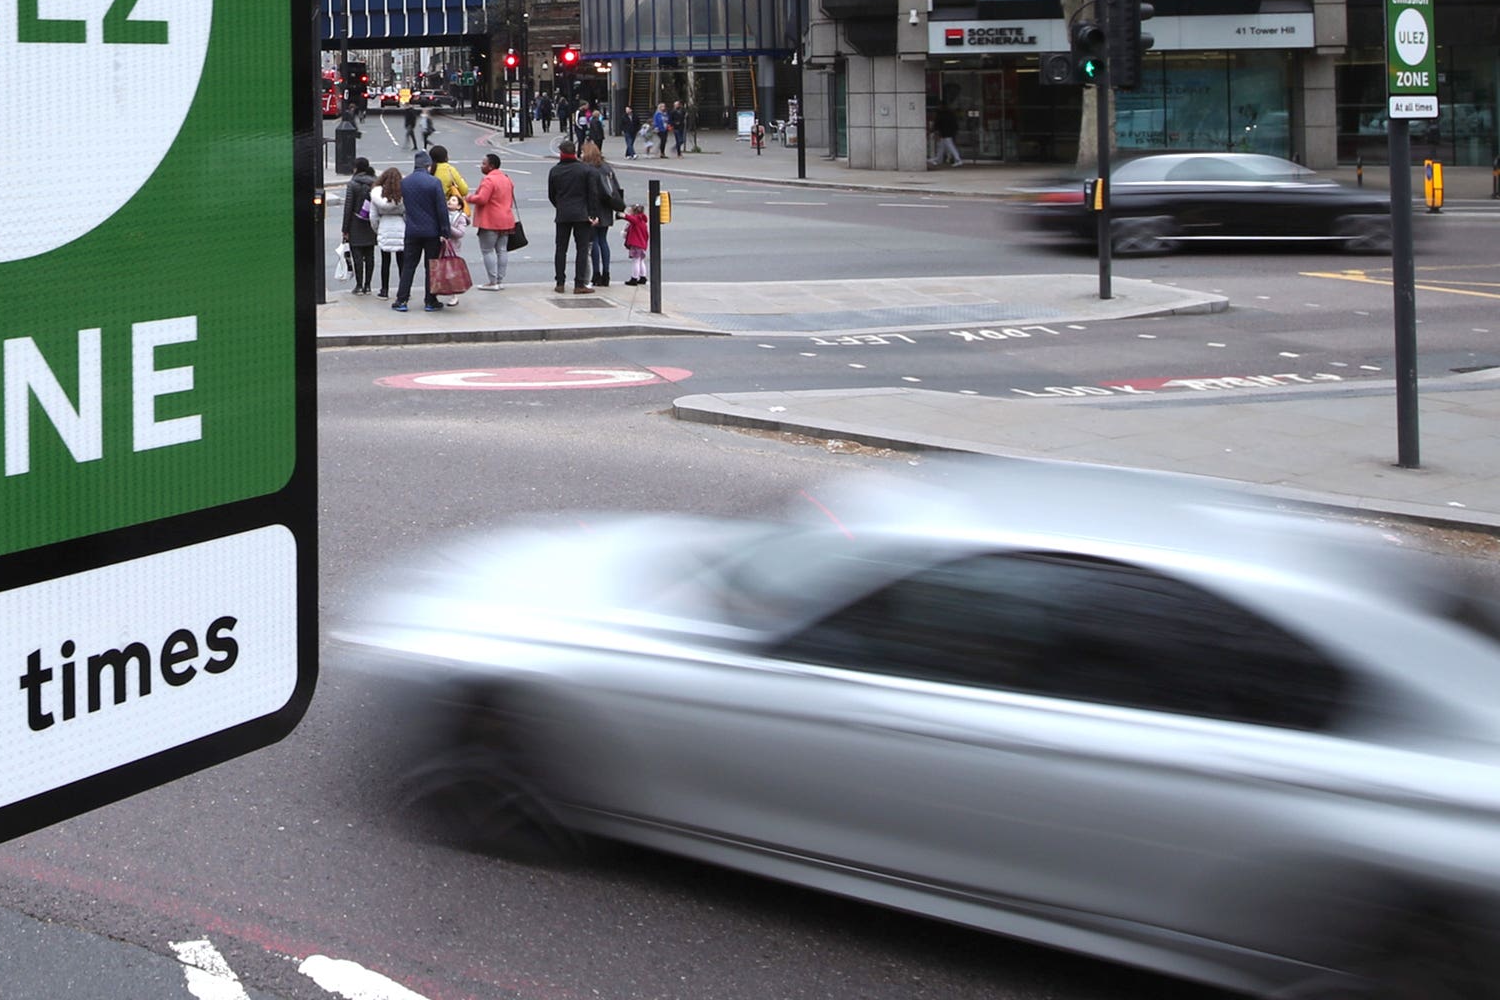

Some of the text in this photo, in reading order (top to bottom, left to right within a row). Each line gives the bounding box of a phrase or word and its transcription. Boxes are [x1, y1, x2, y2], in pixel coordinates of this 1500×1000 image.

[967, 27, 1025, 37] SOCIETE
[1249, 26, 1279, 35] Tower
[1280, 26, 1296, 34] Hill
[967, 36, 1038, 46] GENERALE
[1398, 31, 1425, 45] ULEZ
[1396, 71, 1430, 87] ZONE
[1395, 103, 1403, 112] At
[1414, 102, 1433, 112] times
[809, 325, 1061, 346] LOOK LEFT
[1010, 384, 1156, 398] LOOK
[19, 615, 240, 732] times
